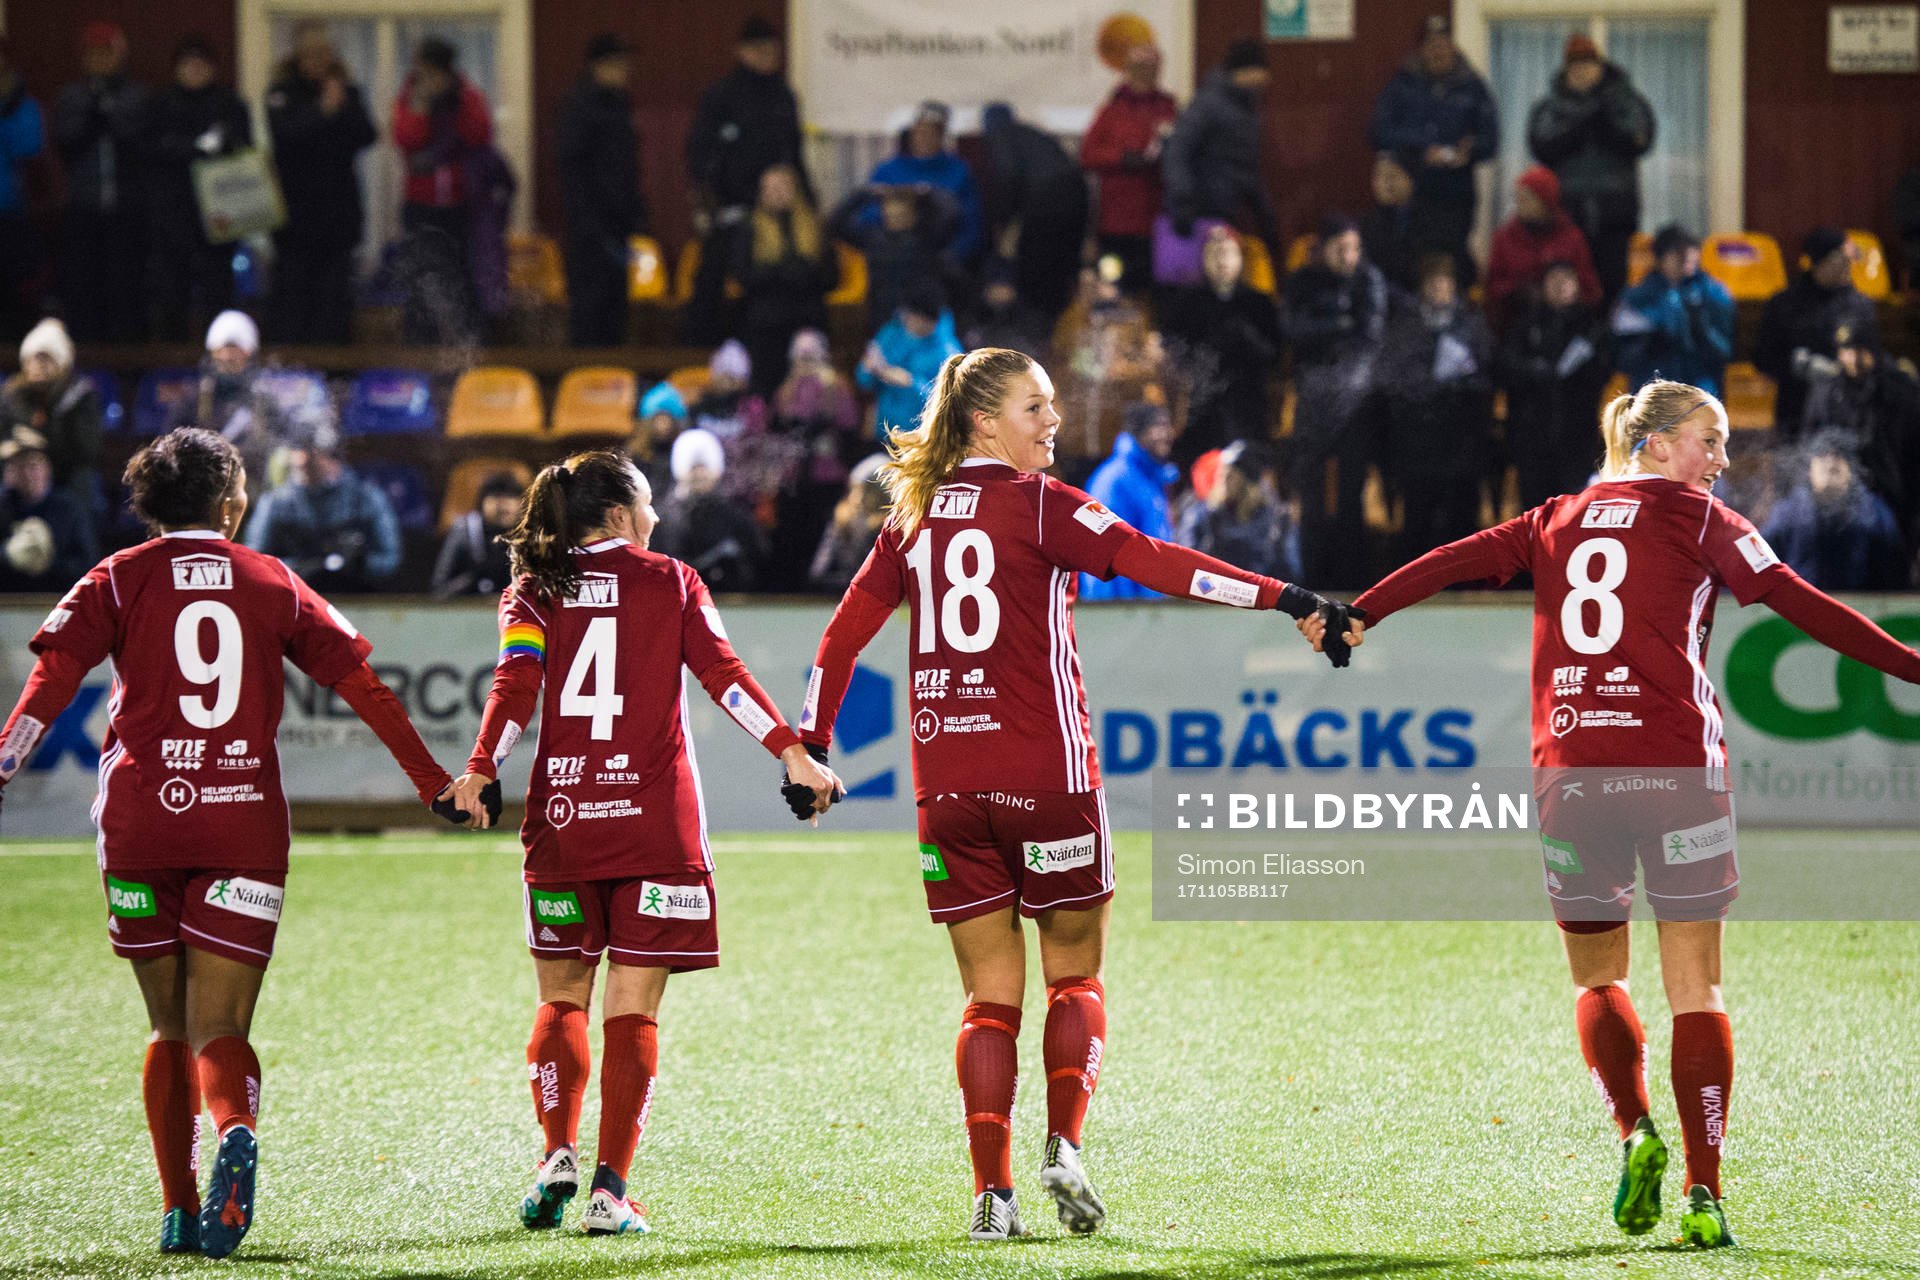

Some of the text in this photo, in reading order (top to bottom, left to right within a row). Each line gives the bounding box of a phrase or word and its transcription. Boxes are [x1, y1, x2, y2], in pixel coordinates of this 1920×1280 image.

[930, 495, 980, 515] RAWI
[1581, 509, 1639, 525] RAWI
[173, 567, 233, 585] RAWI
[905, 528, 1000, 654] 18
[1560, 537, 1628, 655] 8
[174, 600, 244, 729] 9
[560, 616, 624, 741] 4
[1595, 685, 1640, 693] PIREVA
[943, 714, 991, 724] HELIKOPTER
[943, 722, 1001, 733] BRAND DESIGN
[1103, 690, 1477, 774] DBÄCKS
[217, 757, 261, 767] PIREVA
[596, 772, 640, 781] PIREVA
[1602, 778, 1678, 795] KAIDING
[201, 794, 233, 804] BRAND
[578, 799, 632, 811] HELIKOPTER
[578, 806, 642, 820] BRAND DESIGN
[539, 1061, 560, 1113] WIXNERS
[1700, 1085, 1724, 1146] WIXNERS
